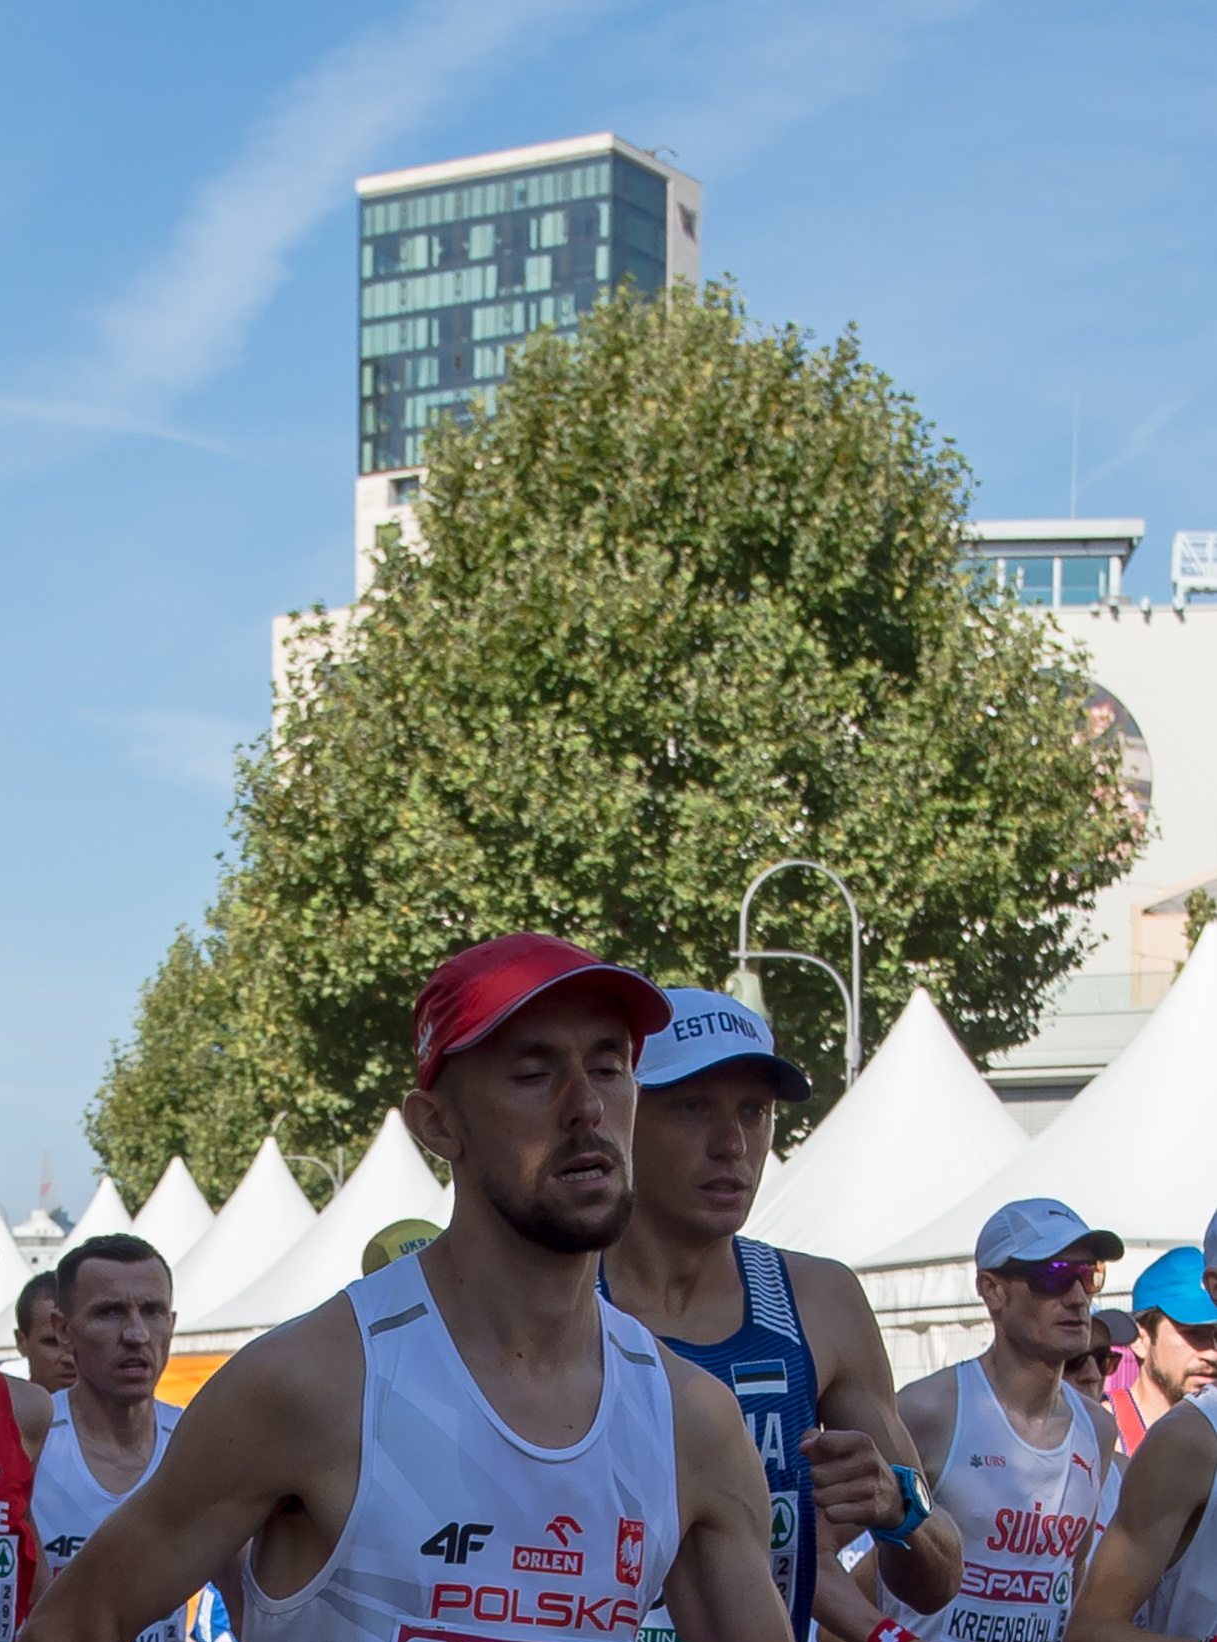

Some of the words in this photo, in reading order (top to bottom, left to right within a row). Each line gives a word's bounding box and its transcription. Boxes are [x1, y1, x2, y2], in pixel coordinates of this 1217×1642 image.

[672, 1011, 762, 1042] ESTONIA
[398, 1237, 435, 1255] UKR
[984, 1455, 1007, 1468] UBS
[44, 1534, 87, 1558] 4F
[419, 1521, 495, 1565] 4F
[516, 1550, 580, 1572] ORLEN
[960, 1565, 1051, 1600] SPAR
